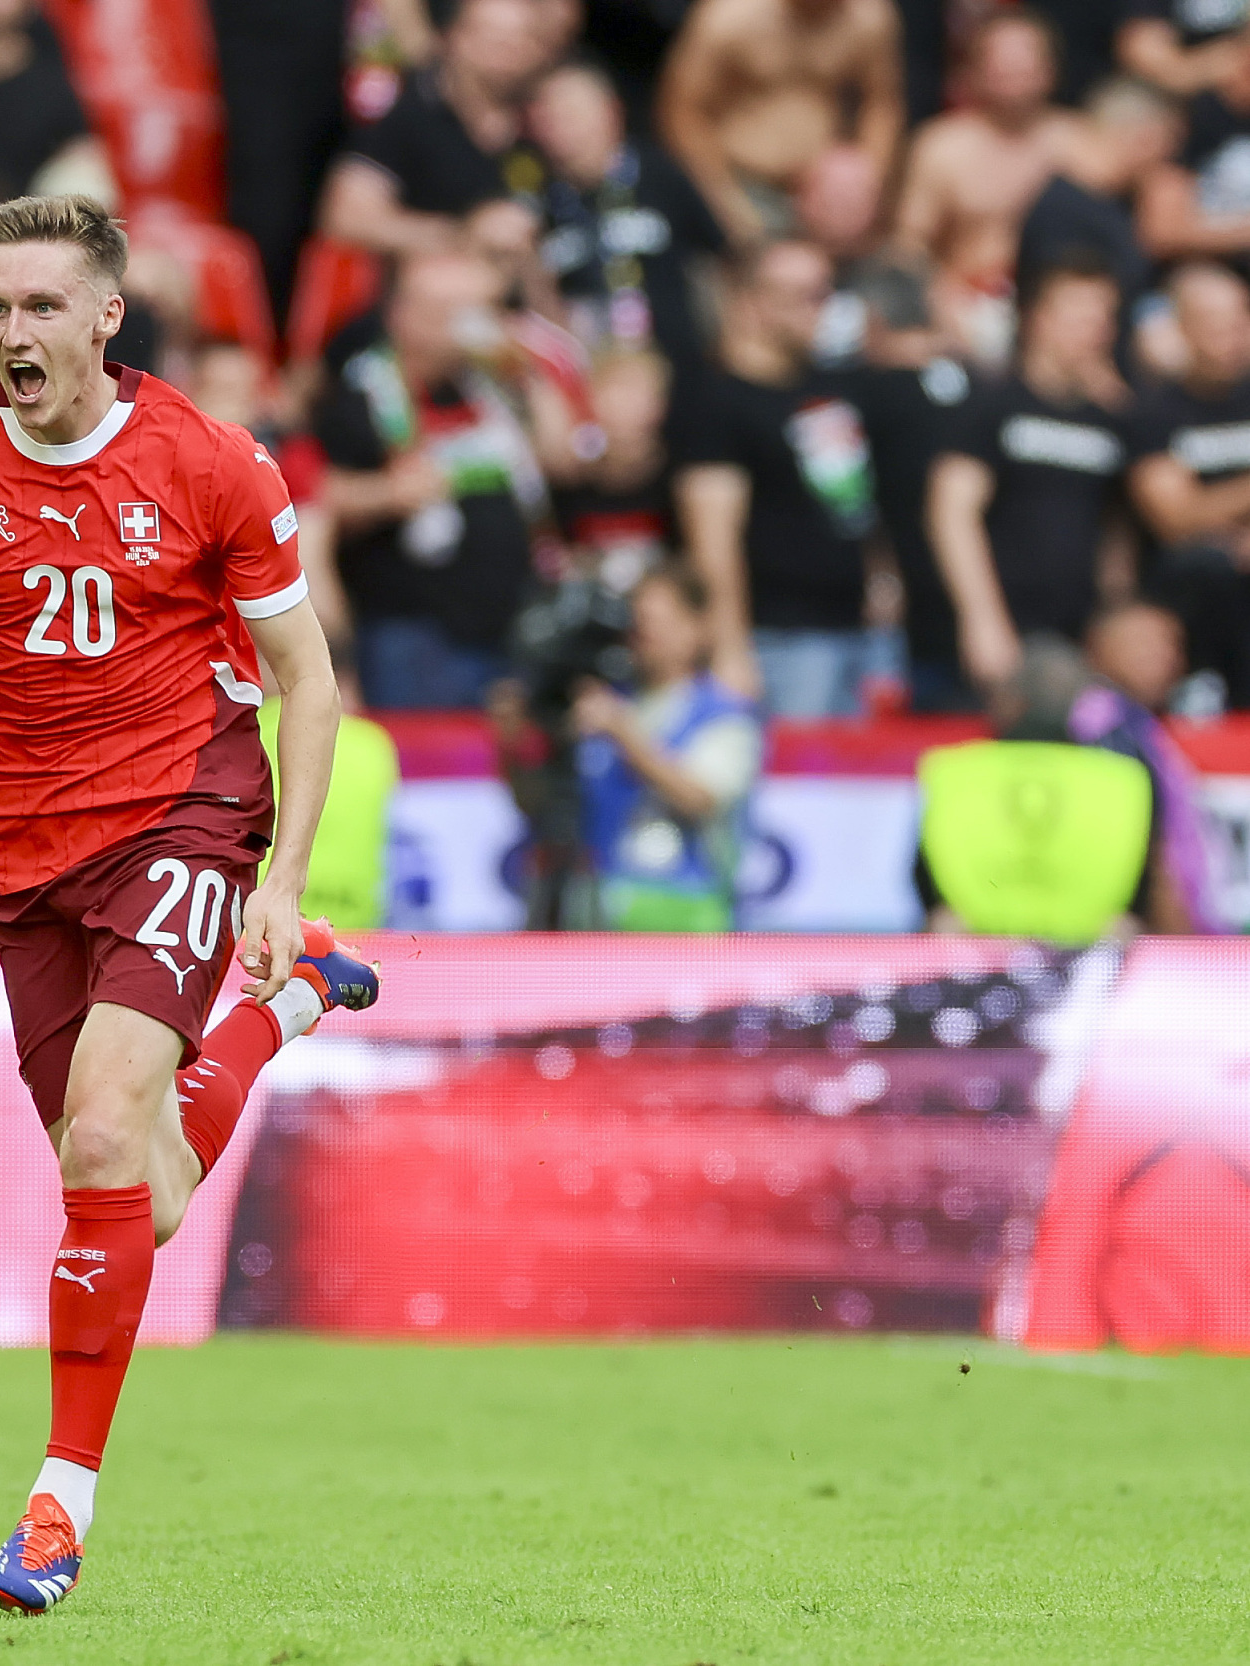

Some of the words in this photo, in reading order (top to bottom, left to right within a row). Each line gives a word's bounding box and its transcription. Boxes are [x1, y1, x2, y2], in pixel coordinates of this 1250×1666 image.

[125, 552, 141, 561] HUN
[147, 551, 160, 560] SUI
[22, 563, 117, 658] 20
[135, 857, 227, 962] 20
